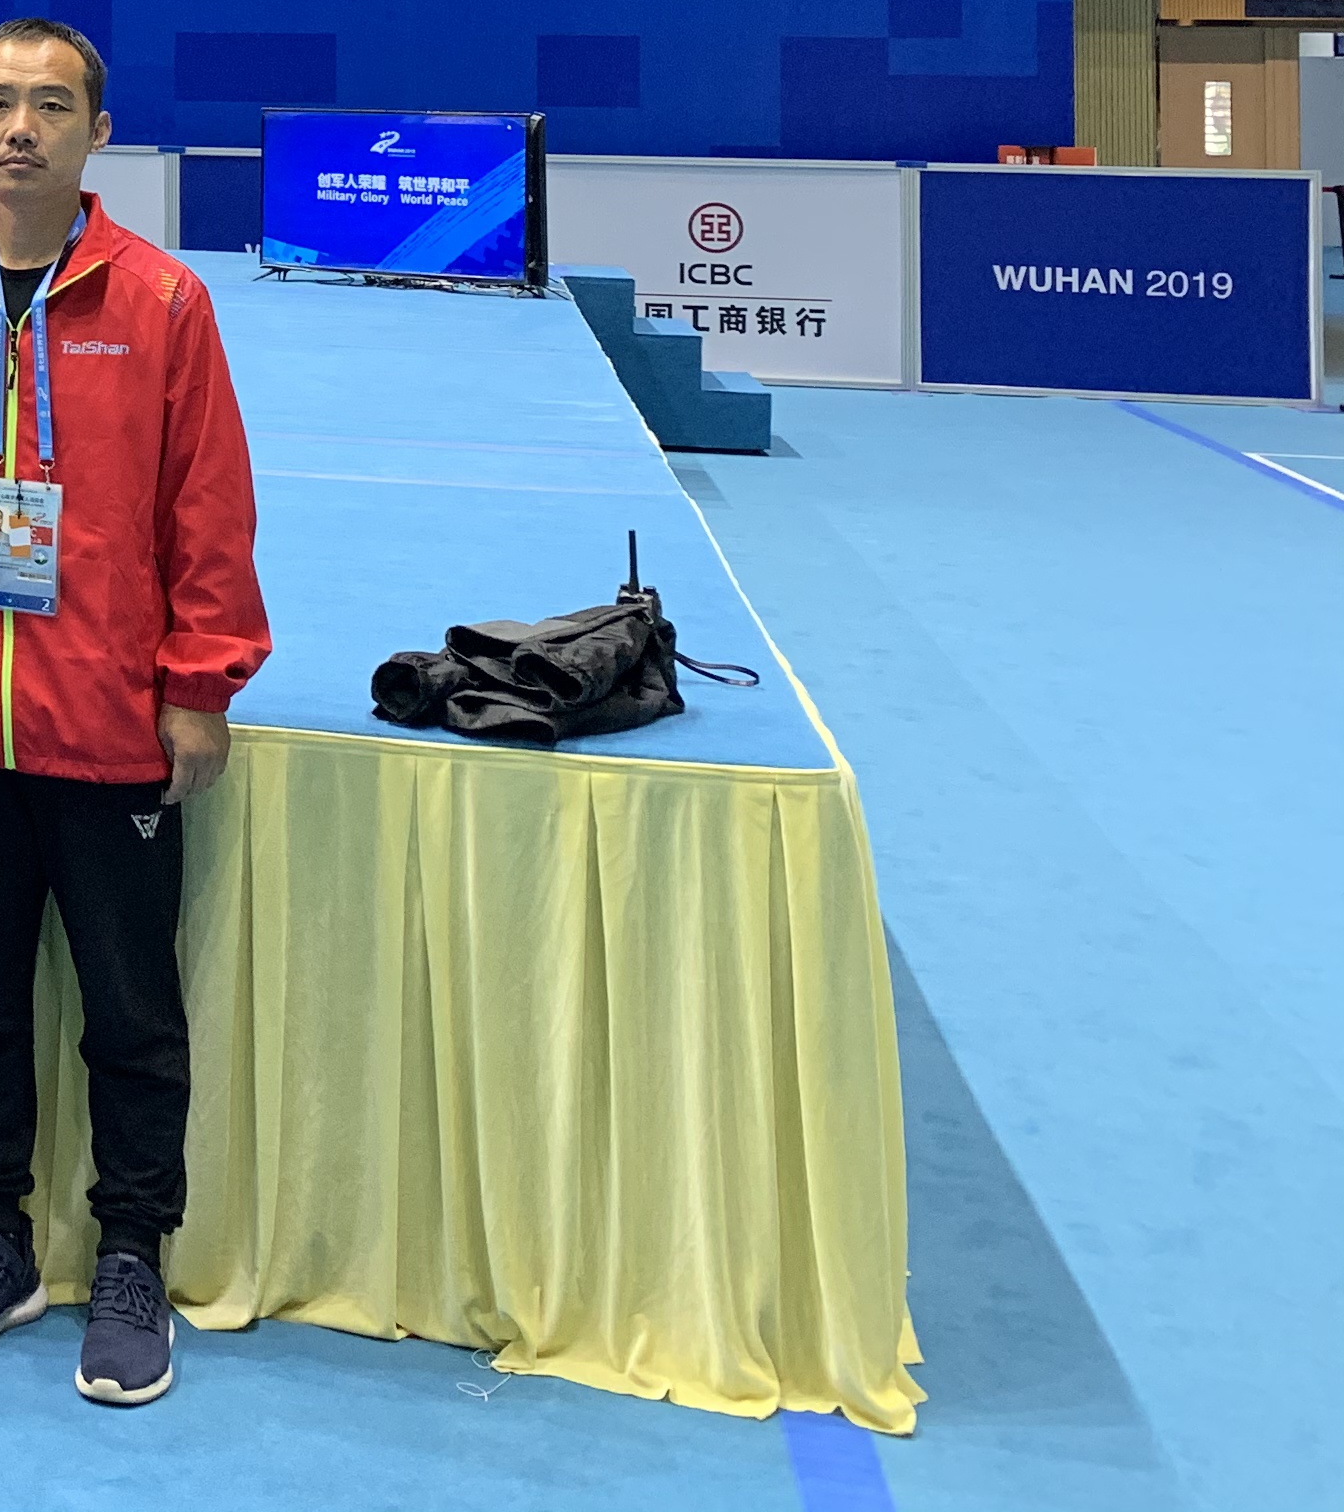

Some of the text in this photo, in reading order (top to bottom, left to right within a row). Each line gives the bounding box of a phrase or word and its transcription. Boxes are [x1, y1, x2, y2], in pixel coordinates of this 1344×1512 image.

[317, 190, 468, 207] Military Glory World Peace
[679, 263, 753, 287] ICBC
[993, 265, 1234, 300] WUHAN 2019
[644, 303, 827, 338] 国工商银行
[61, 341, 130, 355] TaiShan
[42, 599, 50, 611] 2
